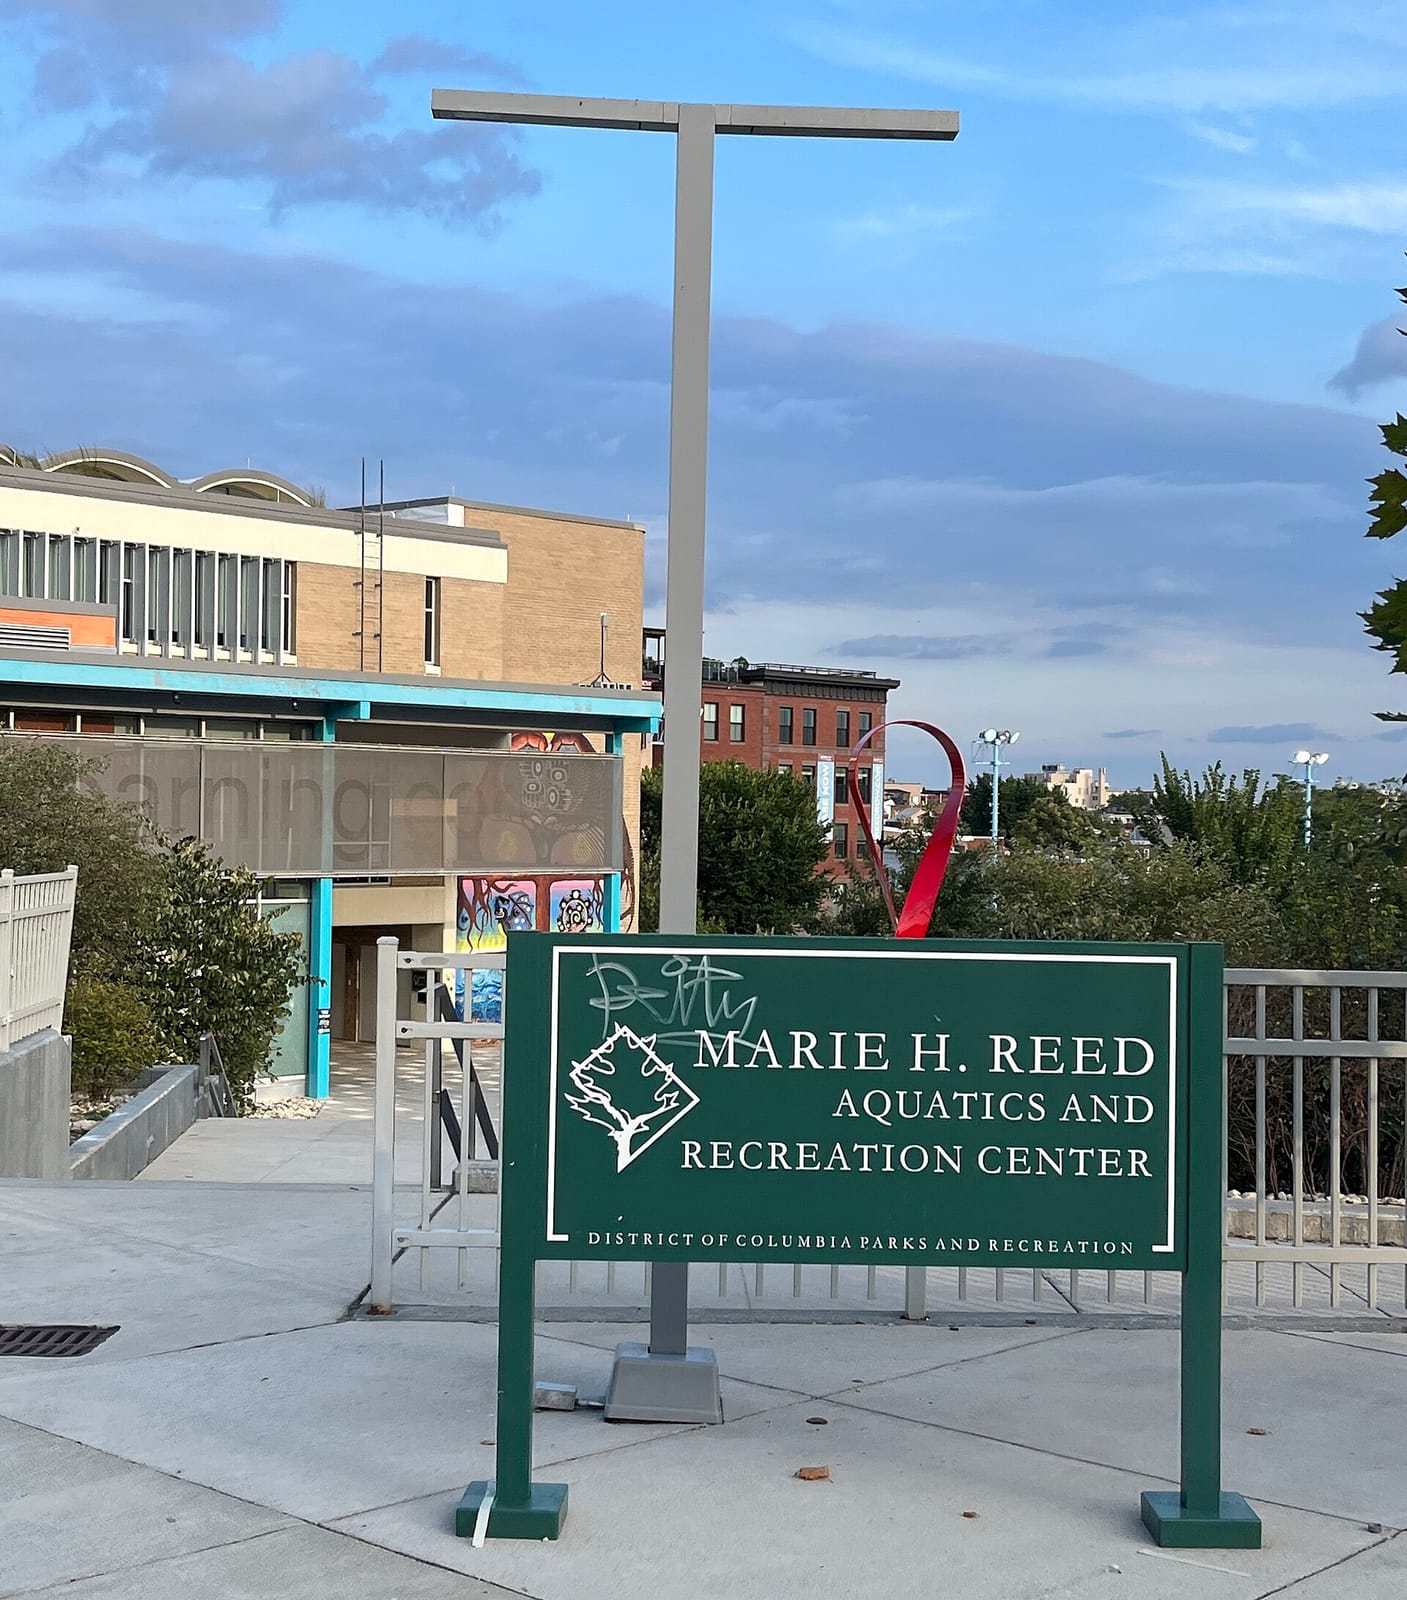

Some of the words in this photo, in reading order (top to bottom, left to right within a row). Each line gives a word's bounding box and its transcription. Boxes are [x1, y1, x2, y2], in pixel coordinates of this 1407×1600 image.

[76, 755, 375, 863] arning
[693, 1029, 890, 1070] MARIE
[909, 1033, 967, 1073] H.
[988, 1034, 1155, 1076] REED
[831, 1088, 1046, 1127] AQUATICS
[1058, 1093, 1154, 1124] AND
[680, 1140, 963, 1174] RECREATION
[977, 1145, 1153, 1178] CENTER
[588, 1232, 694, 1246] DISTRICT
[701, 1234, 729, 1247] OF
[735, 1234, 851, 1249] COLUMBIA
[860, 1236, 927, 1250] PARKS
[935, 1237, 980, 1251] AND
[989, 1239, 1134, 1255] RECREATION
